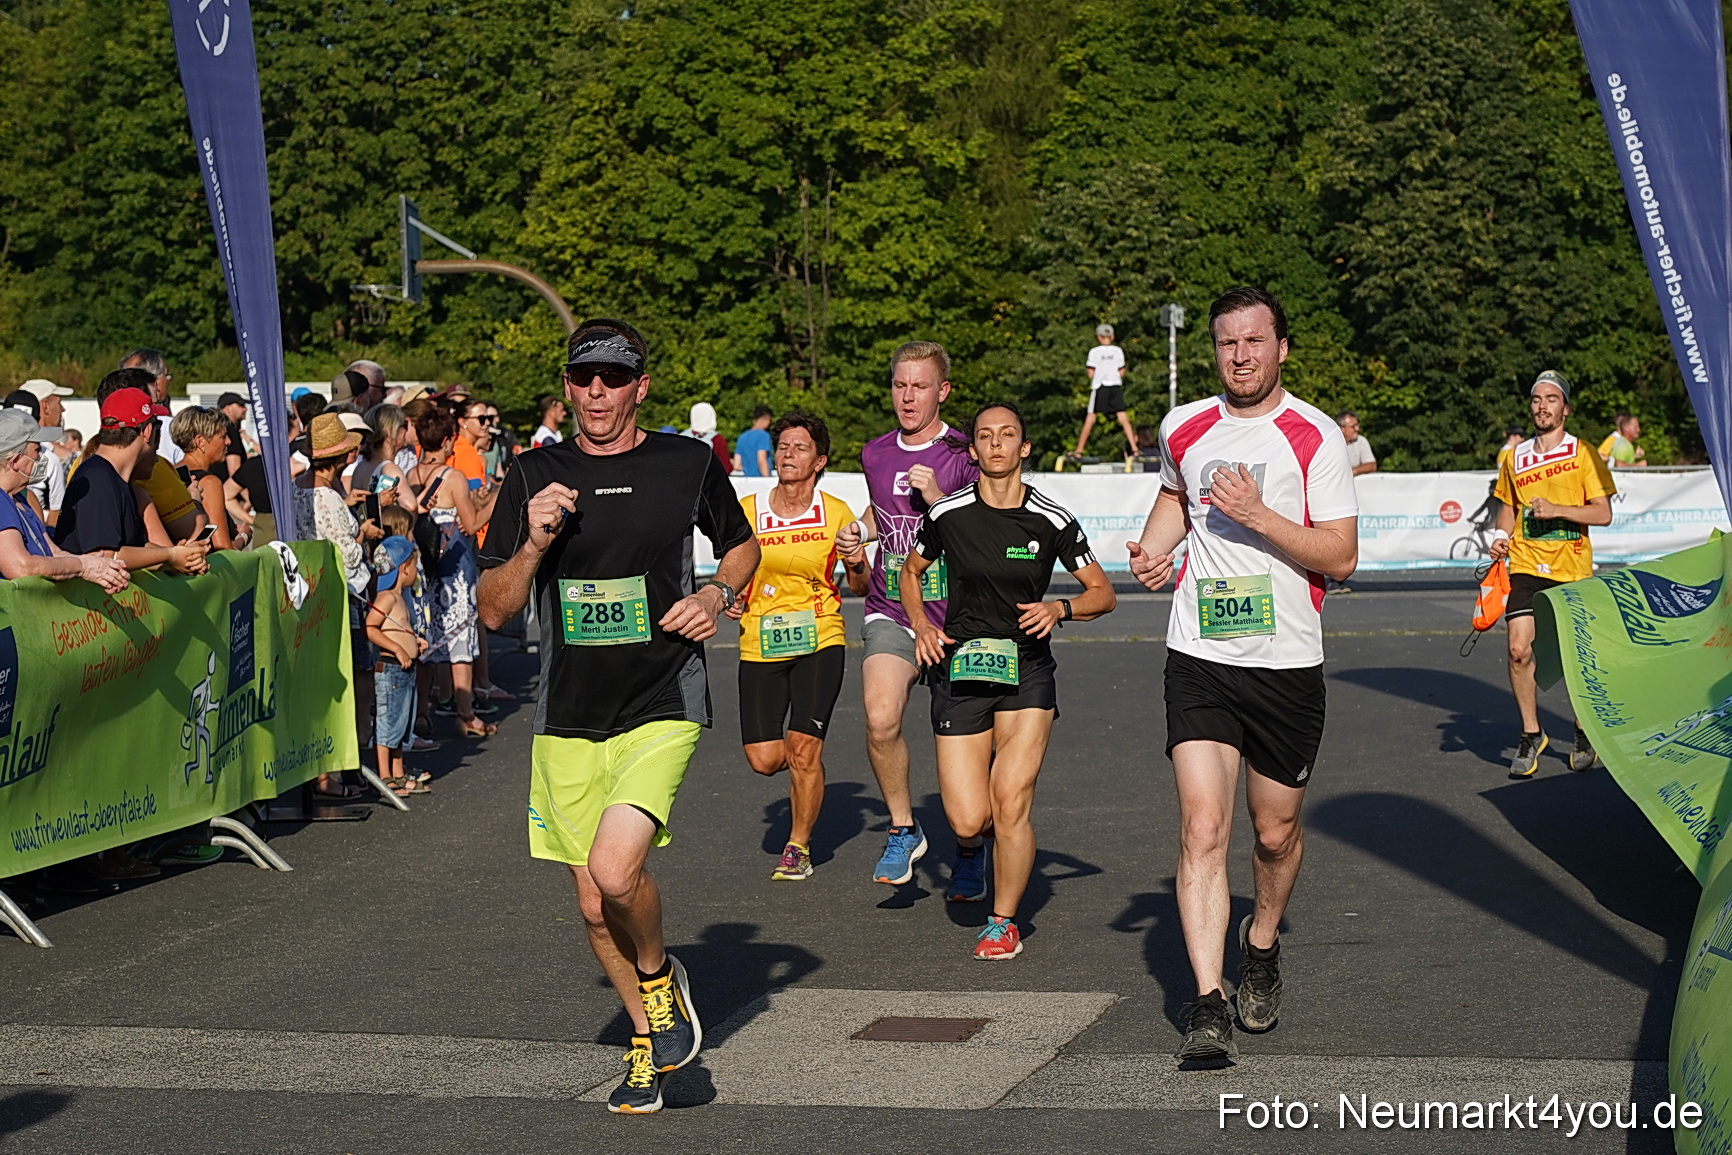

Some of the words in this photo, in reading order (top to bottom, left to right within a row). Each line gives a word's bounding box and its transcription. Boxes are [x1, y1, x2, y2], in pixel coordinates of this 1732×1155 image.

[1516, 462, 1542, 488] MAX
[1545, 461, 1579, 478] BÖGL
[756, 535, 787, 547] MAX
[791, 531, 828, 544] BÖGL
[1006, 546, 1028, 554] physio
[581, 602, 625, 624] 288
[635, 602, 646, 632] 2022
[1214, 596, 1253, 618] 504
[1262, 598, 1271, 625] 2022
[51, 598, 108, 656] Gesunde
[566, 609, 575, 632] RUN
[603, 625, 629, 633] Justin
[1233, 617, 1264, 625] Matthias
[773, 627, 803, 643] 815
[808, 627, 816, 647] 2022
[962, 653, 1007, 669] 1239
[1008, 658, 1016, 679] 2022
